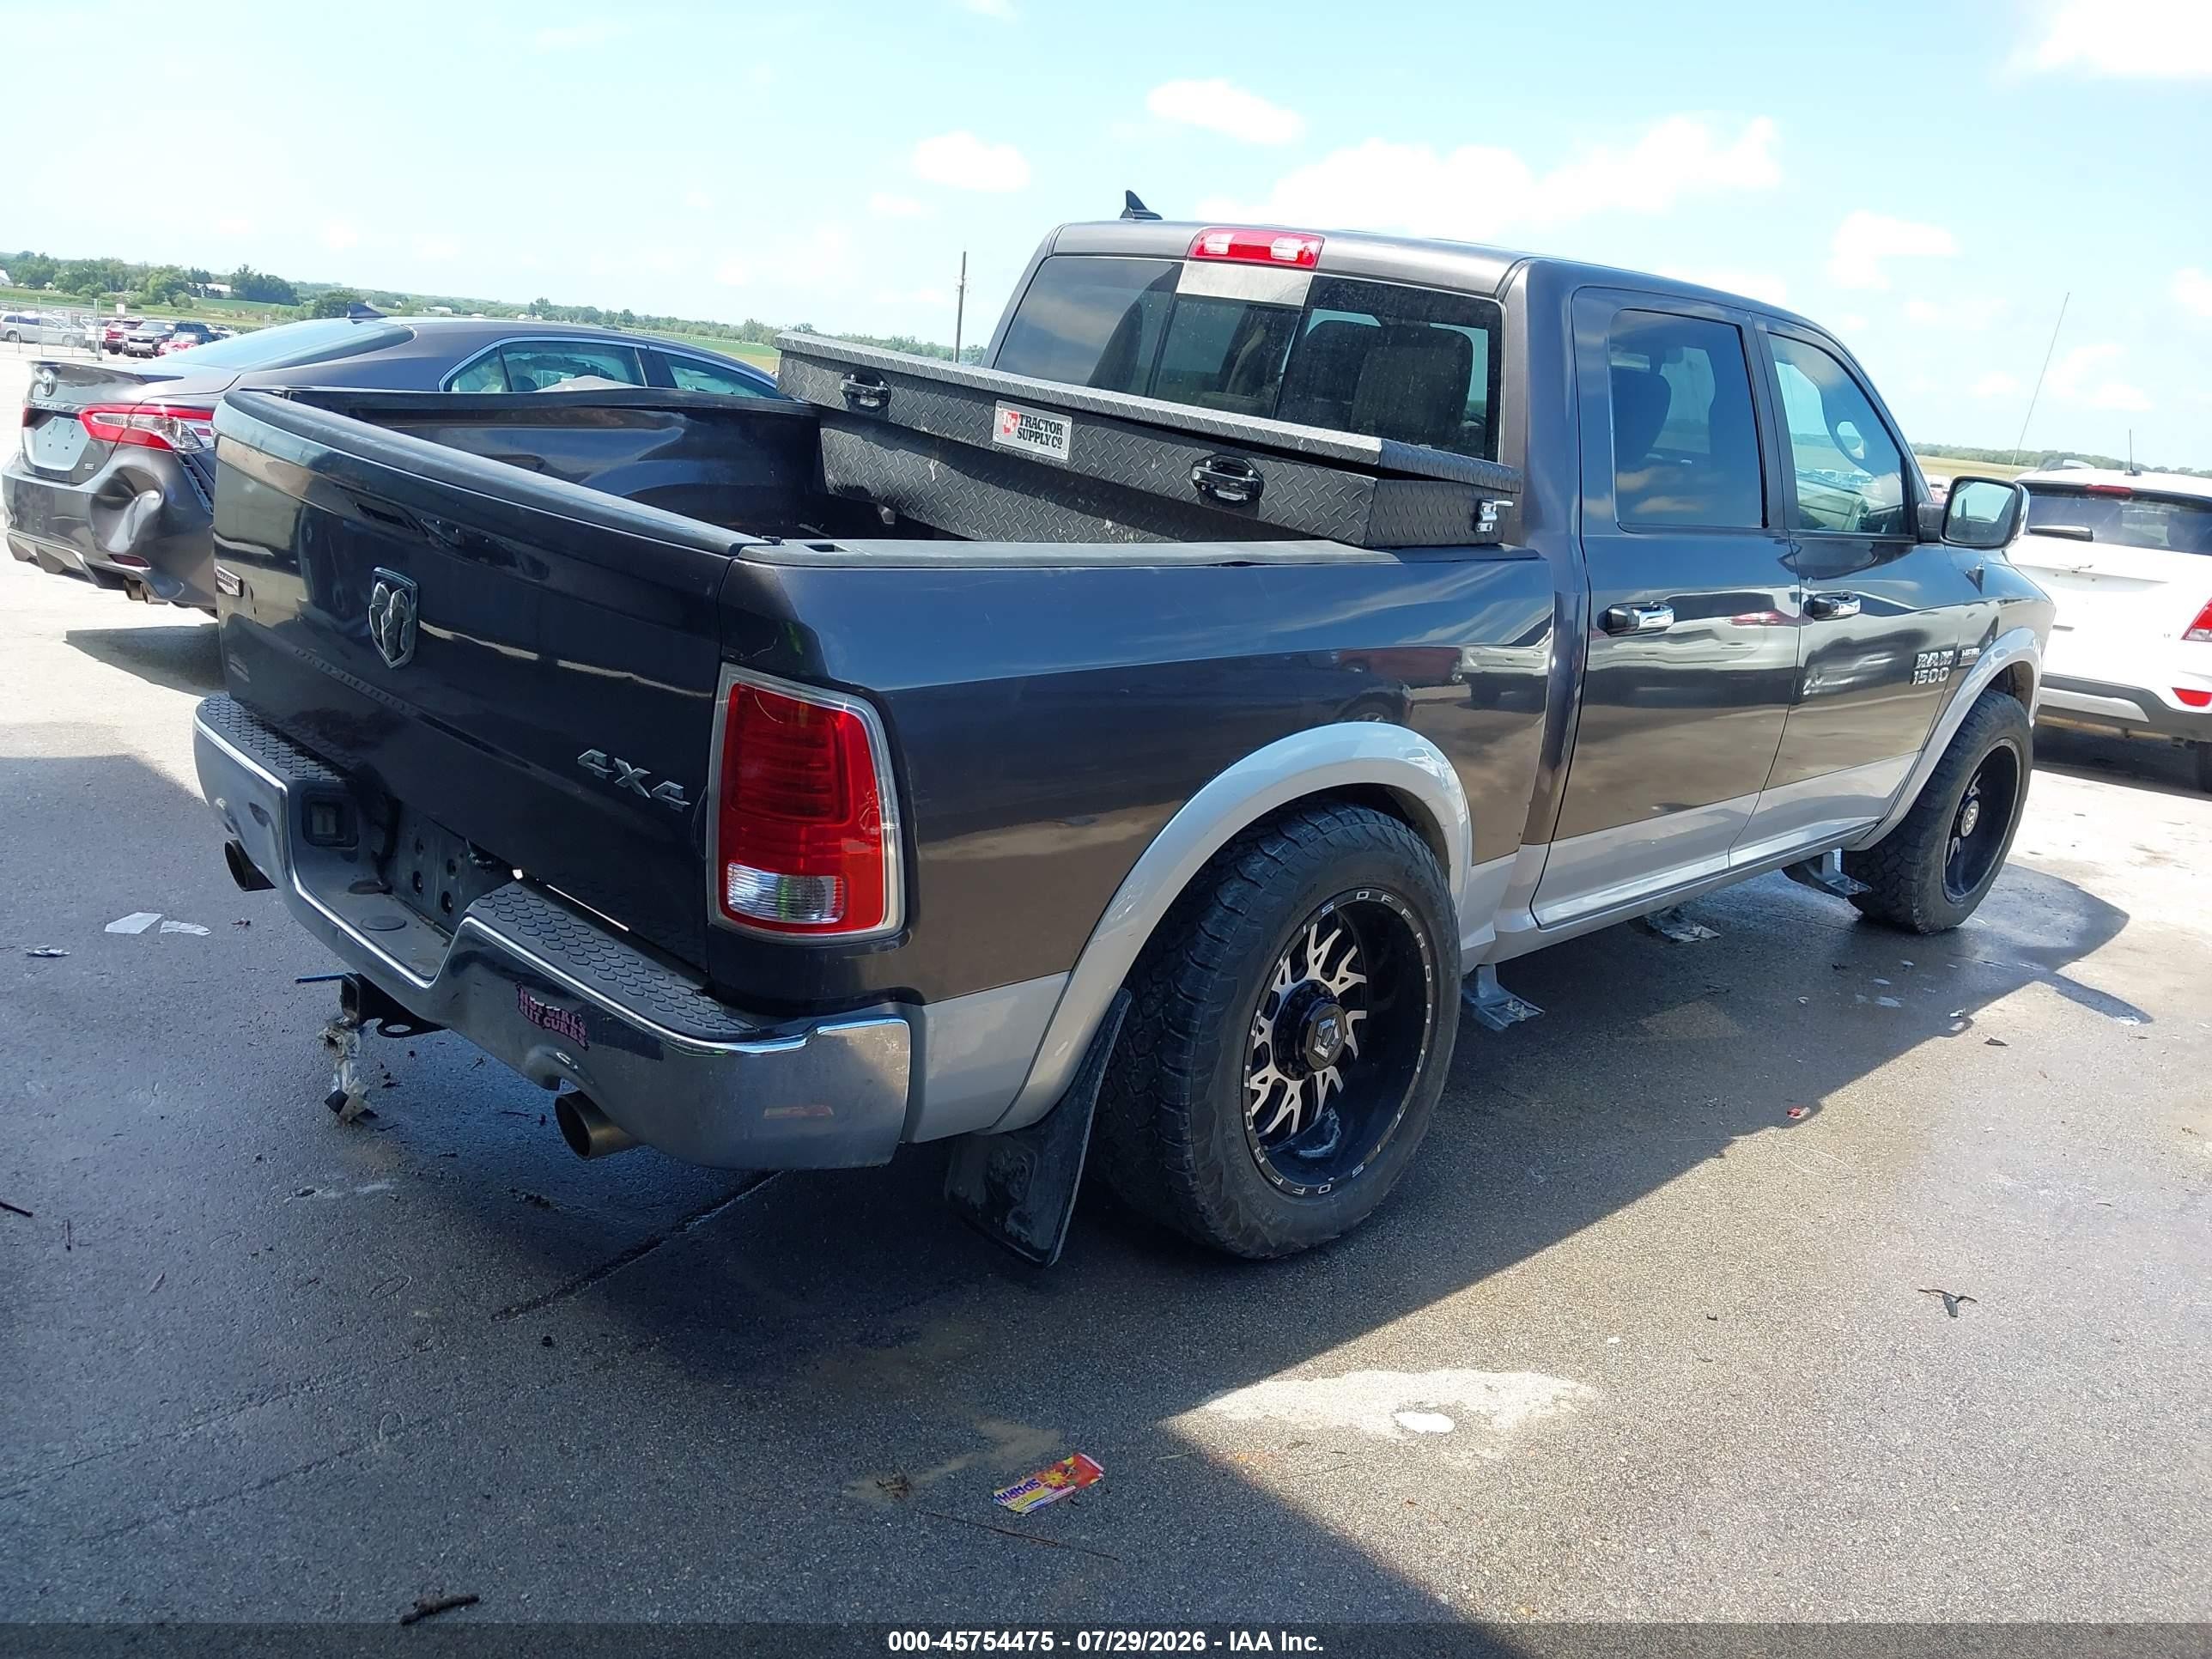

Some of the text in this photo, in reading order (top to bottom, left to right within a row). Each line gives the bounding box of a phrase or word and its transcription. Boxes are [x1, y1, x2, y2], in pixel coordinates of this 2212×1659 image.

[1019, 414, 1063, 435] TRACTOR
[1017, 427, 1051, 447] SUPPLY
[1916, 650, 1954, 669] RAM
[1911, 667, 1949, 685] 1500
